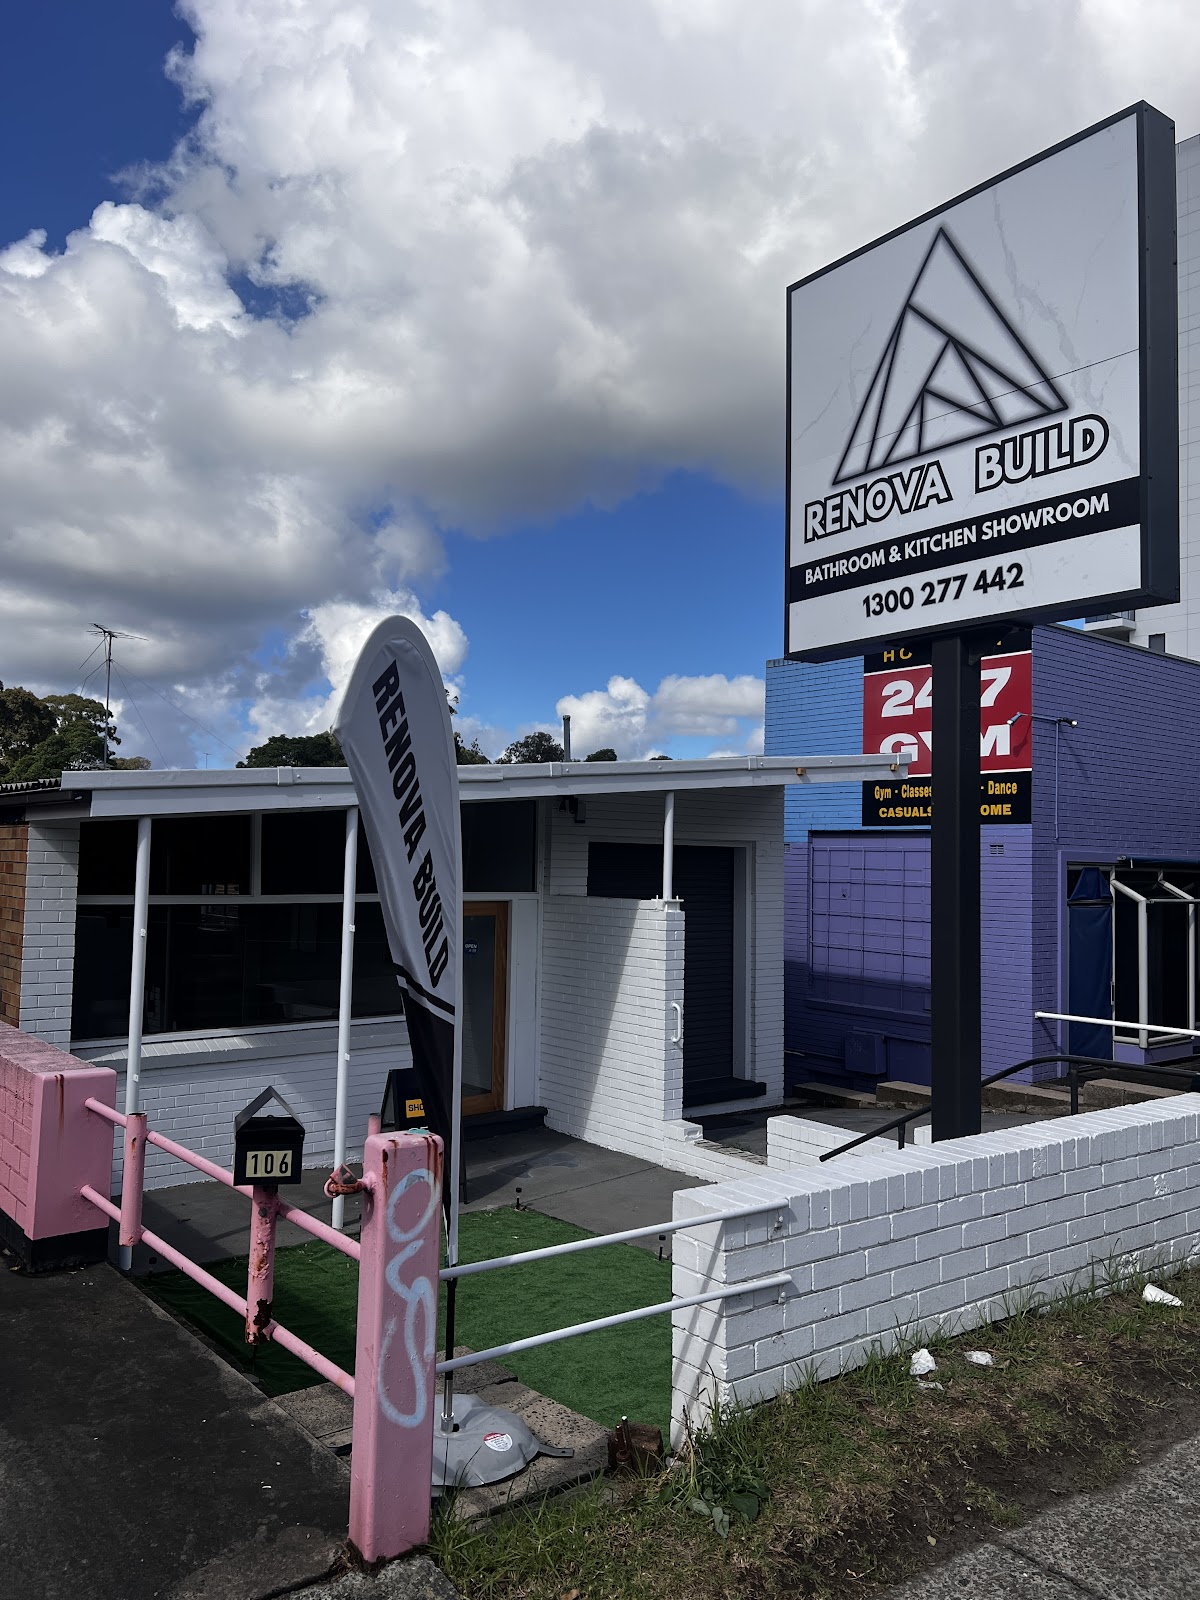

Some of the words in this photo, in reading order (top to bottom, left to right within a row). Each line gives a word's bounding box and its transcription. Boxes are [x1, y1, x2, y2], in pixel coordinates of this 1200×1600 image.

[804, 460, 954, 545] RENOVA
[975, 414, 1110, 494] BUILD
[805, 548, 885, 585] BATHROOM
[888, 545, 902, 563] &
[904, 525, 977, 559] KITCHEN
[981, 493, 1110, 540] SHOWROOM
[863, 587, 914, 618] 1300
[921, 574, 968, 607] 277
[973, 563, 1025, 594] 442
[372, 660, 427, 864] RENOVA
[412, 849, 449, 989] BUILD
[874, 785, 892, 801] Gym
[987, 780, 1018, 795] Dance
[250, 1153, 289, 1175] 106
